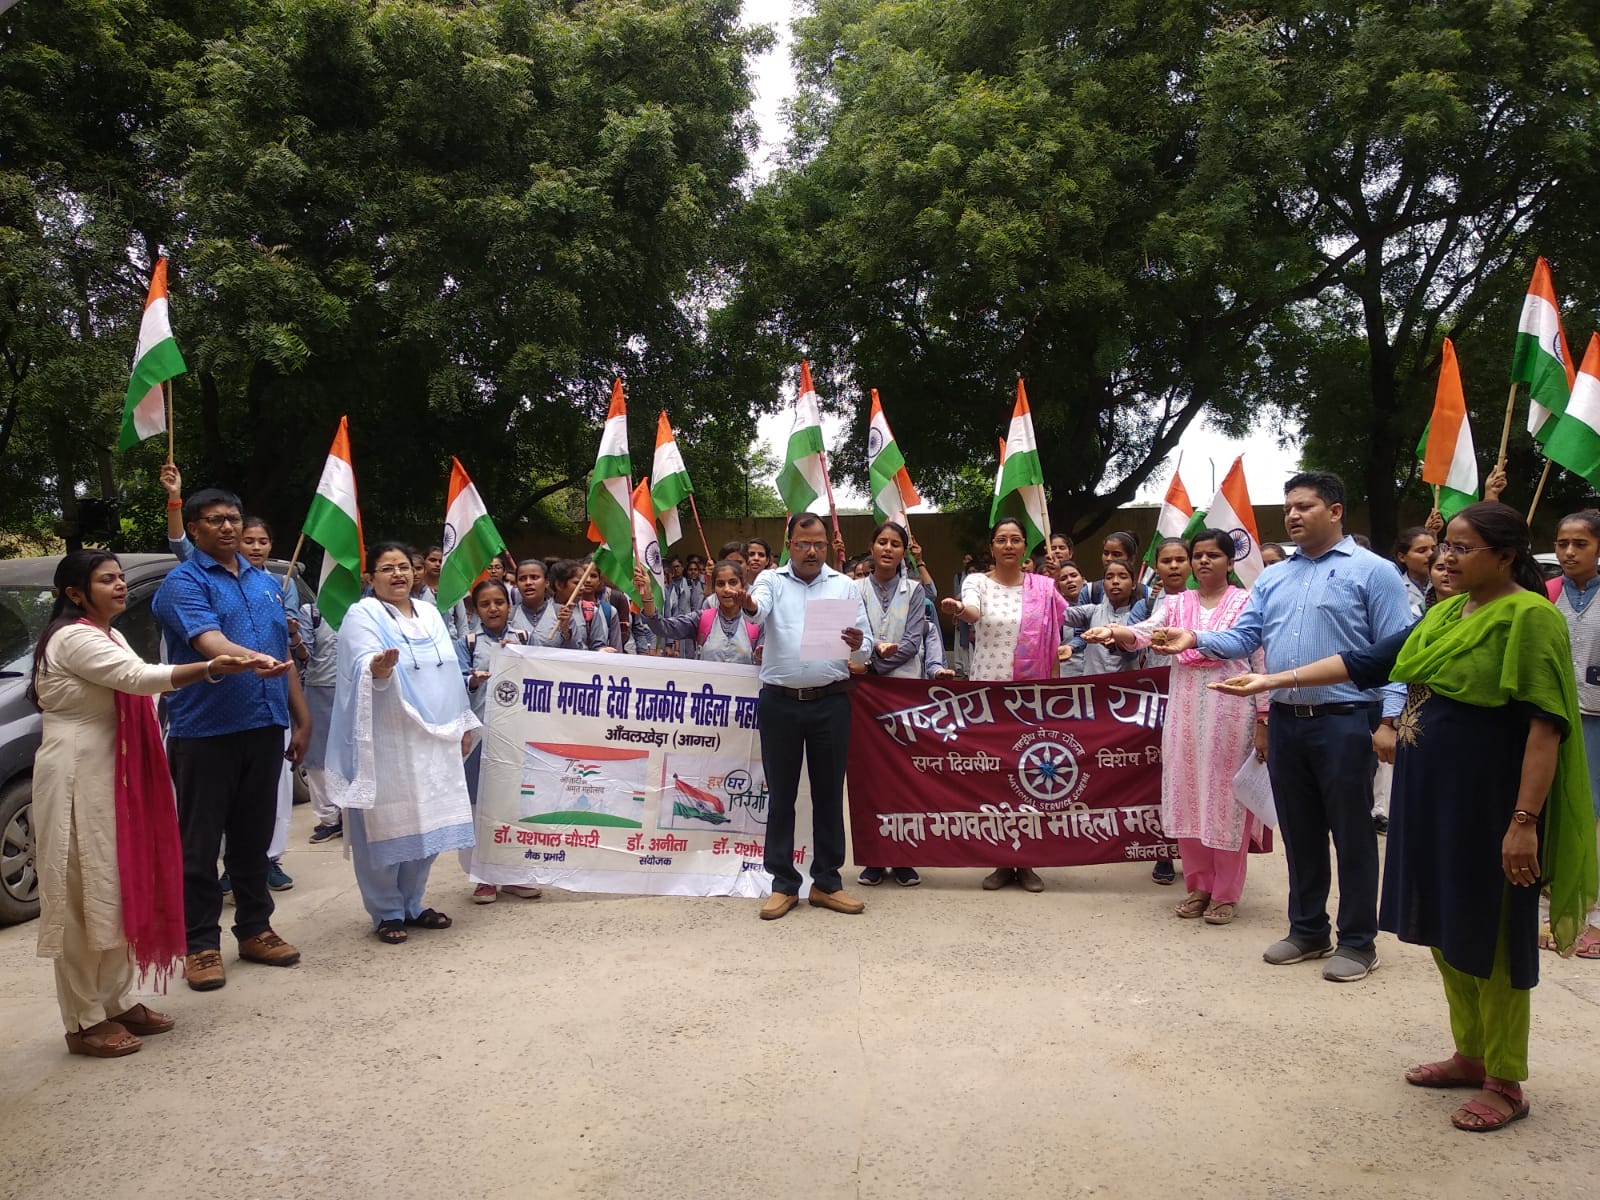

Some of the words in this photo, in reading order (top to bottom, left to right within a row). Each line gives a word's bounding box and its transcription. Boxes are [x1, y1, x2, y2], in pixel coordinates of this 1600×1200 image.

[522, 678, 554, 713] माता
[557, 674, 603, 717] भगवती
[606, 675, 632, 719] देवी
[635, 680, 687, 723] राजकीय
[690, 683, 731, 727] महिला
[734, 695, 760, 729] महा
[876, 686, 995, 746] राष्ट्रीय
[1107, 677, 1169, 729] यो
[672, 729, 721, 752] (आगरा)
[912, 756, 944, 774] सप्त
[947, 750, 1001, 775] दिवसीय
[1095, 747, 1141, 769] विशेष
[727, 777, 747, 790] घर
[1008, 773, 1036, 807] NATIONAL
[1040, 797, 1073, 811] SERVICE
[494, 825, 512, 844] डॉ.
[516, 830, 562, 848] यशपाल
[565, 828, 600, 848] चौधरी
[876, 812, 926, 848] माता
[1046, 802, 1119, 844] महिला
[626, 833, 644, 851] डॉ.
[648, 833, 688, 852] अनीता
[712, 837, 730, 855] डॉ.
[733, 840, 765, 857] यशोध
[639, 855, 672, 865] संयोजक
